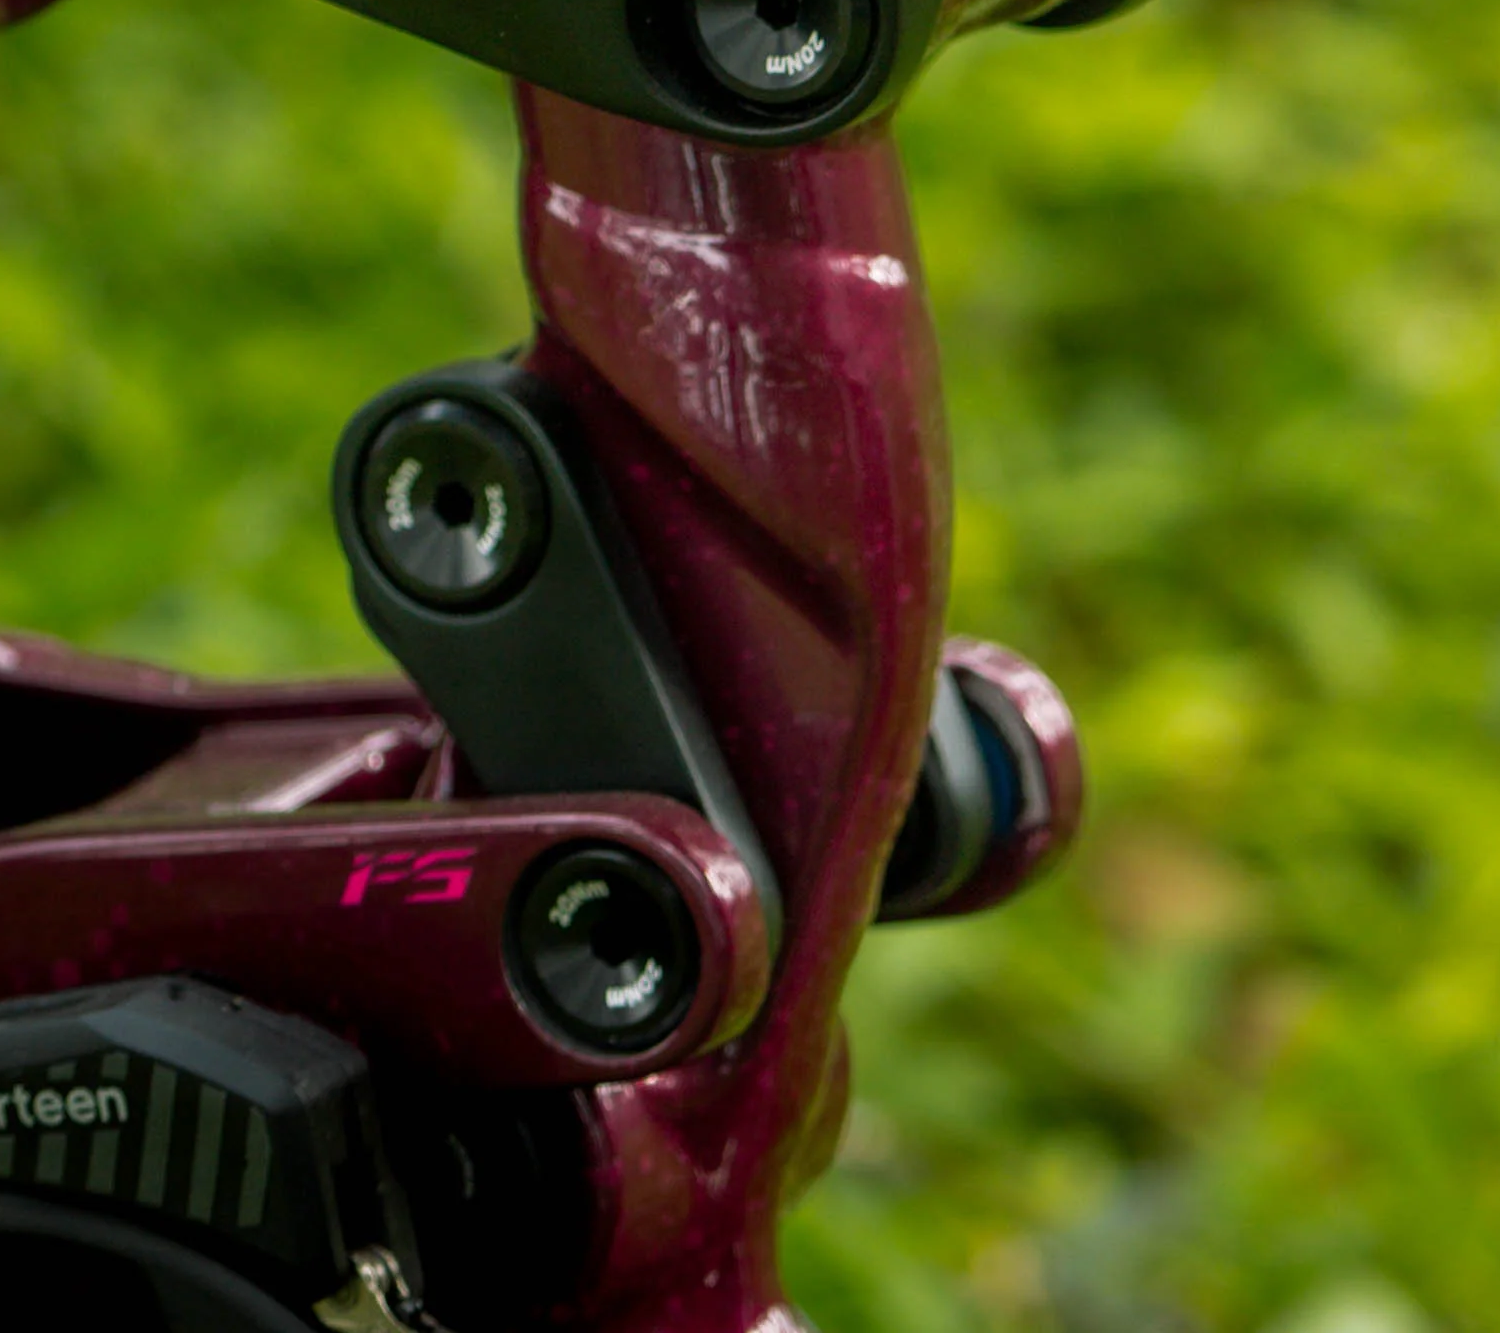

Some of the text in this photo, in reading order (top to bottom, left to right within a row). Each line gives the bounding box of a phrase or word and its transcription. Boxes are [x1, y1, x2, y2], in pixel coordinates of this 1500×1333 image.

[765, 29, 825, 76] 20Nm
[385, 457, 422, 531] 20Nm
[476, 483, 507, 554] 20Nm
[549, 880, 610, 928] 20Nm
[605, 957, 663, 1008] 20Nm
